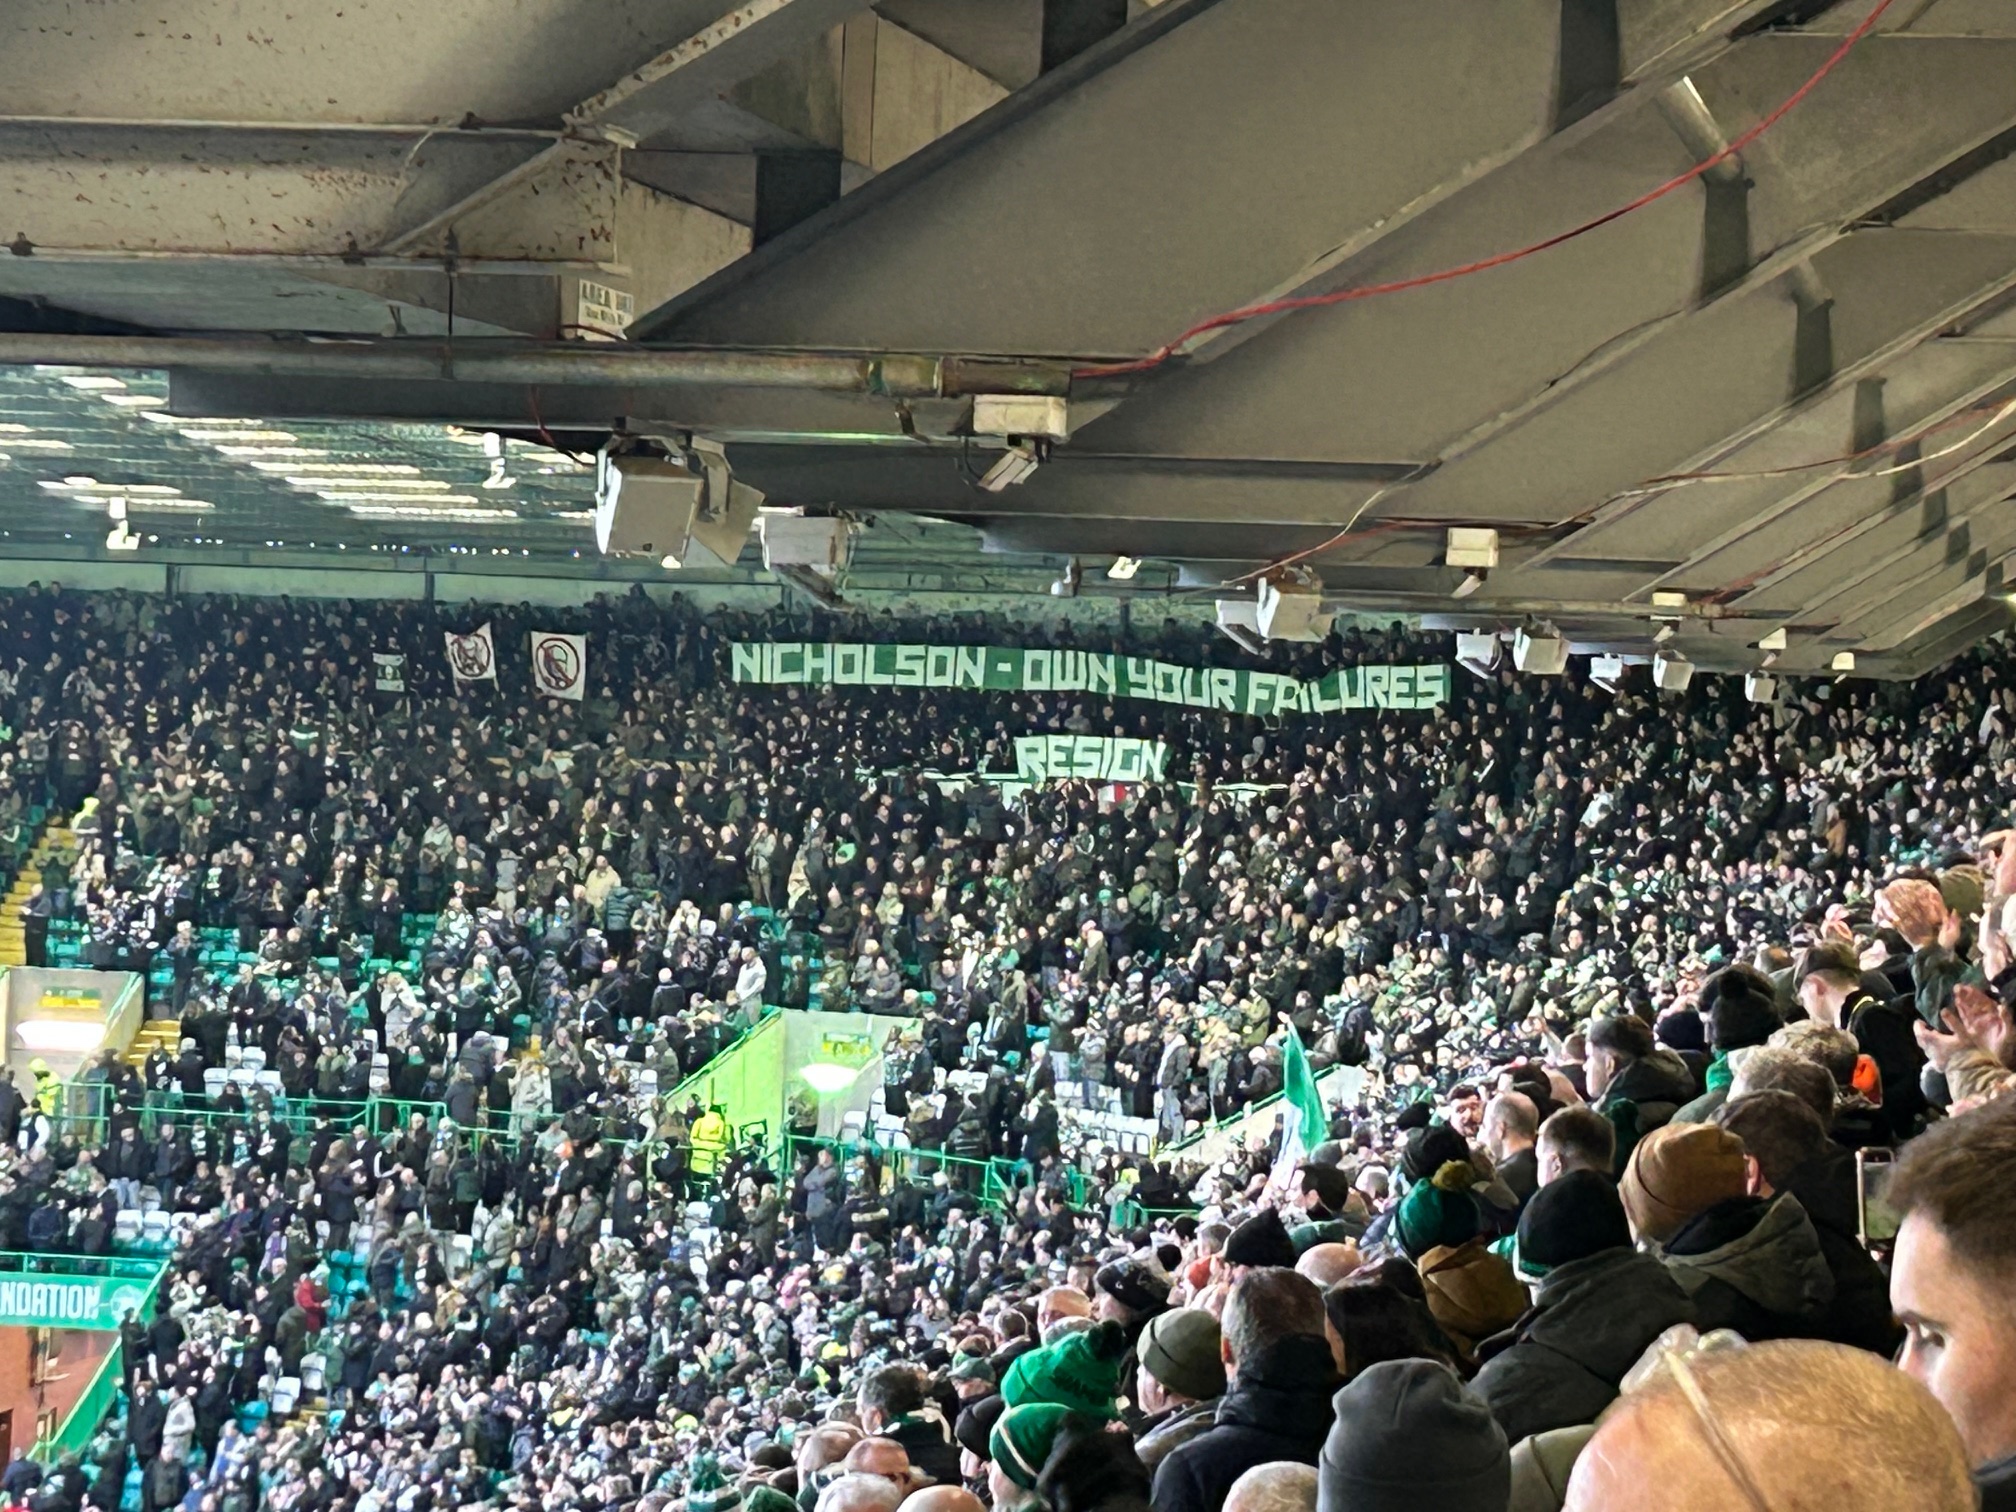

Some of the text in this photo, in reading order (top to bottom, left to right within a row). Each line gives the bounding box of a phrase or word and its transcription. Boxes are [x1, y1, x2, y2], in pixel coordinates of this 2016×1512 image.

[732, 642, 1444, 715] NICHOLSON - OWN YOUR FAILURES
[1014, 735, 1167, 783] RESIGN
[0, 1281, 100, 1320] NDATION
